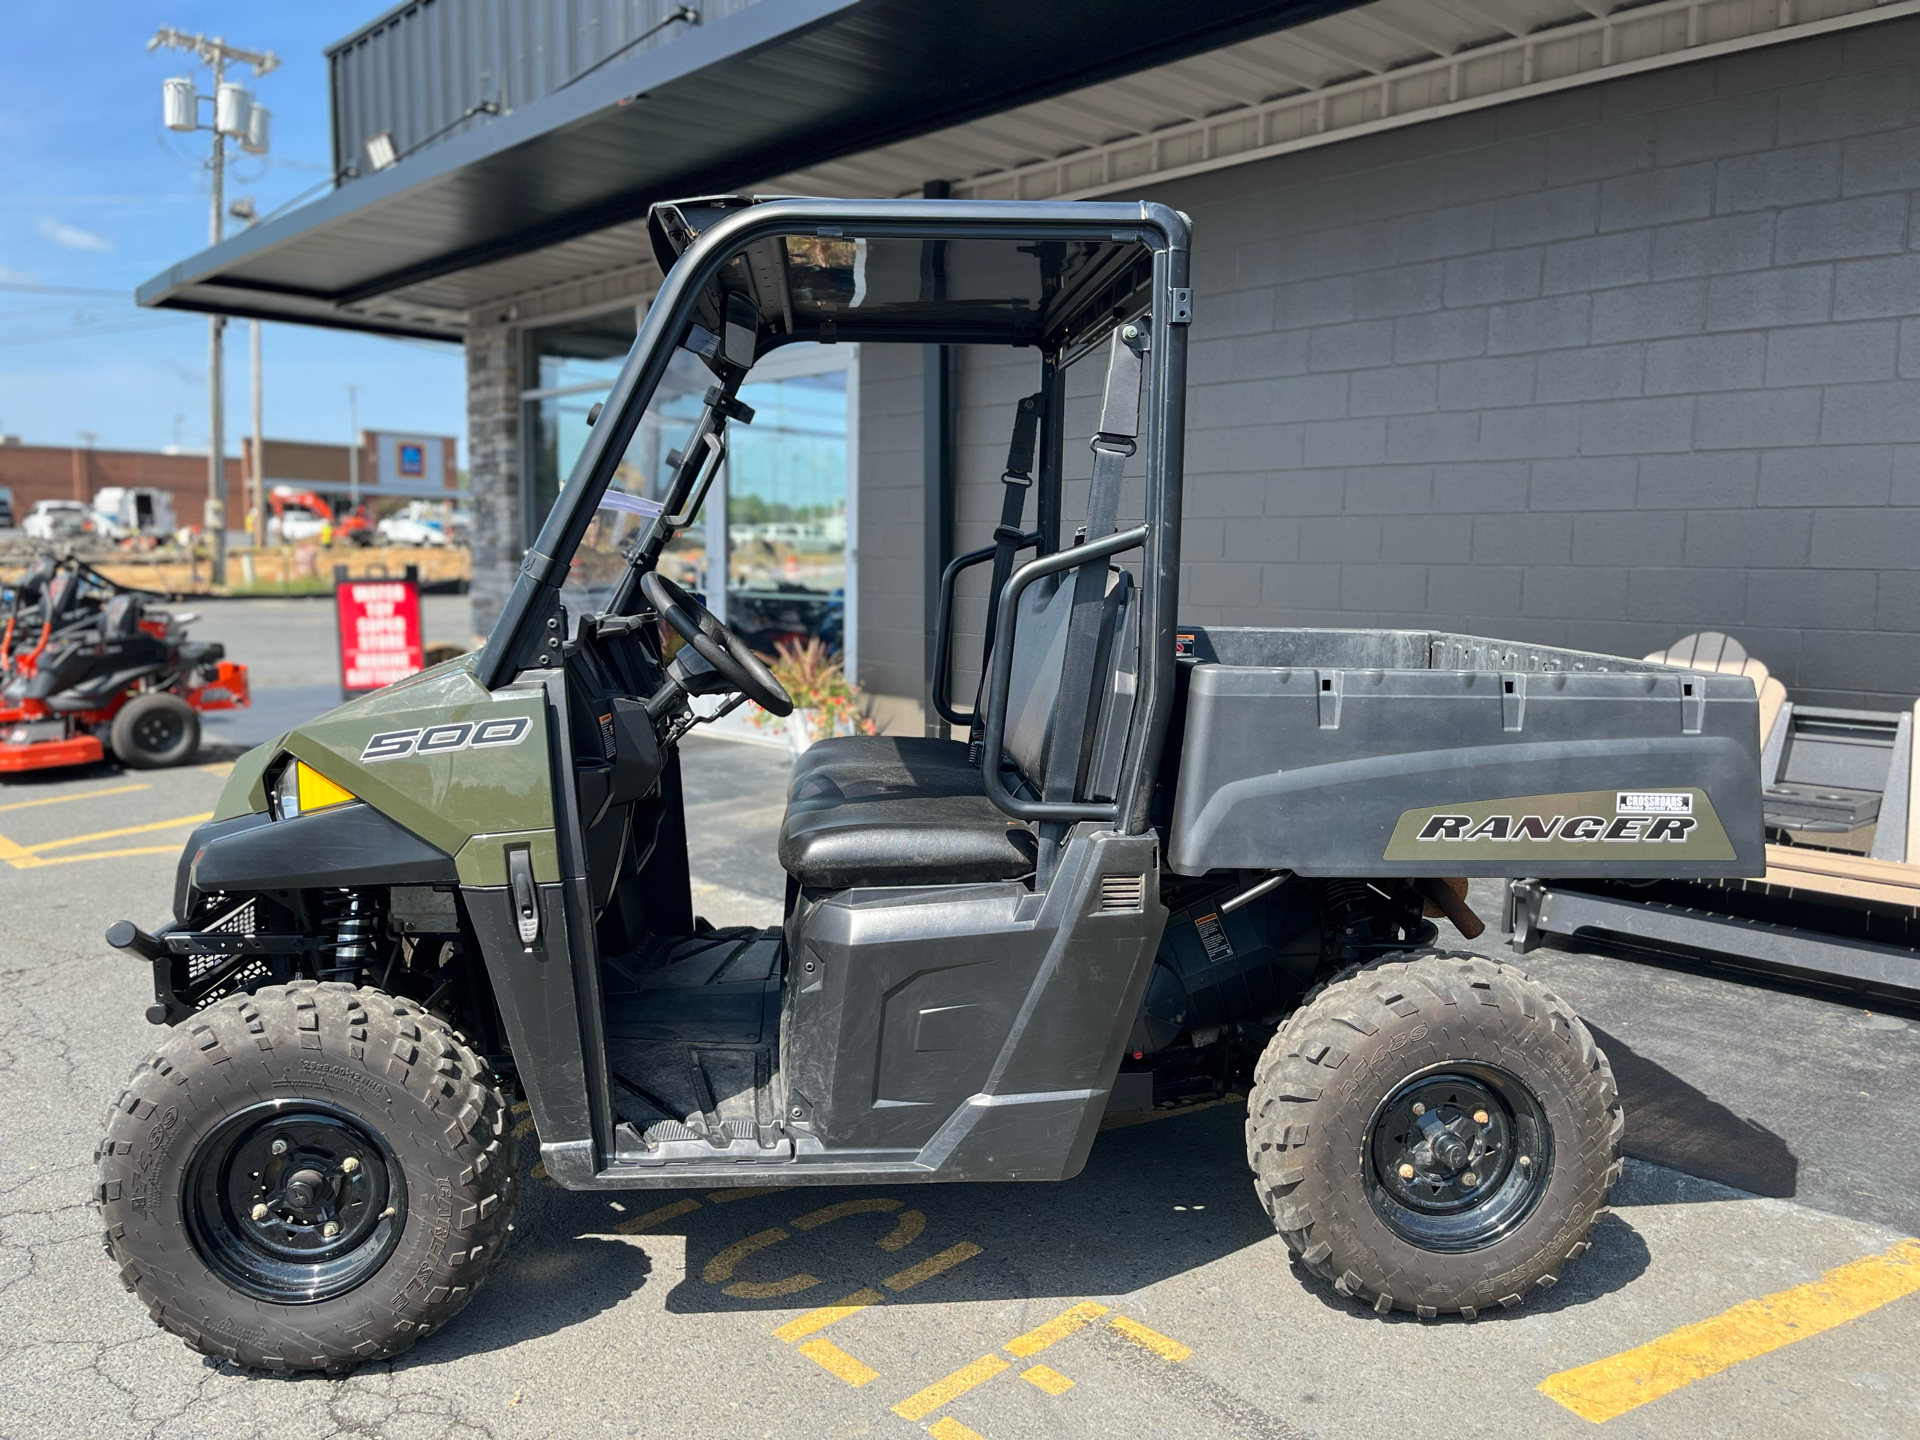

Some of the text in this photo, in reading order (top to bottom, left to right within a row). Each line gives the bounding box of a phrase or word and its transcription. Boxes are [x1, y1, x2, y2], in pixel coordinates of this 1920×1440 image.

[359, 716, 533, 764] 500
[1626, 795, 1683, 807] CROSSROADS
[1416, 814, 1698, 843] RANGER
[391, 1178, 453, 1312] CARLISLE
[1479, 1202, 1584, 1295] CARLISLE
